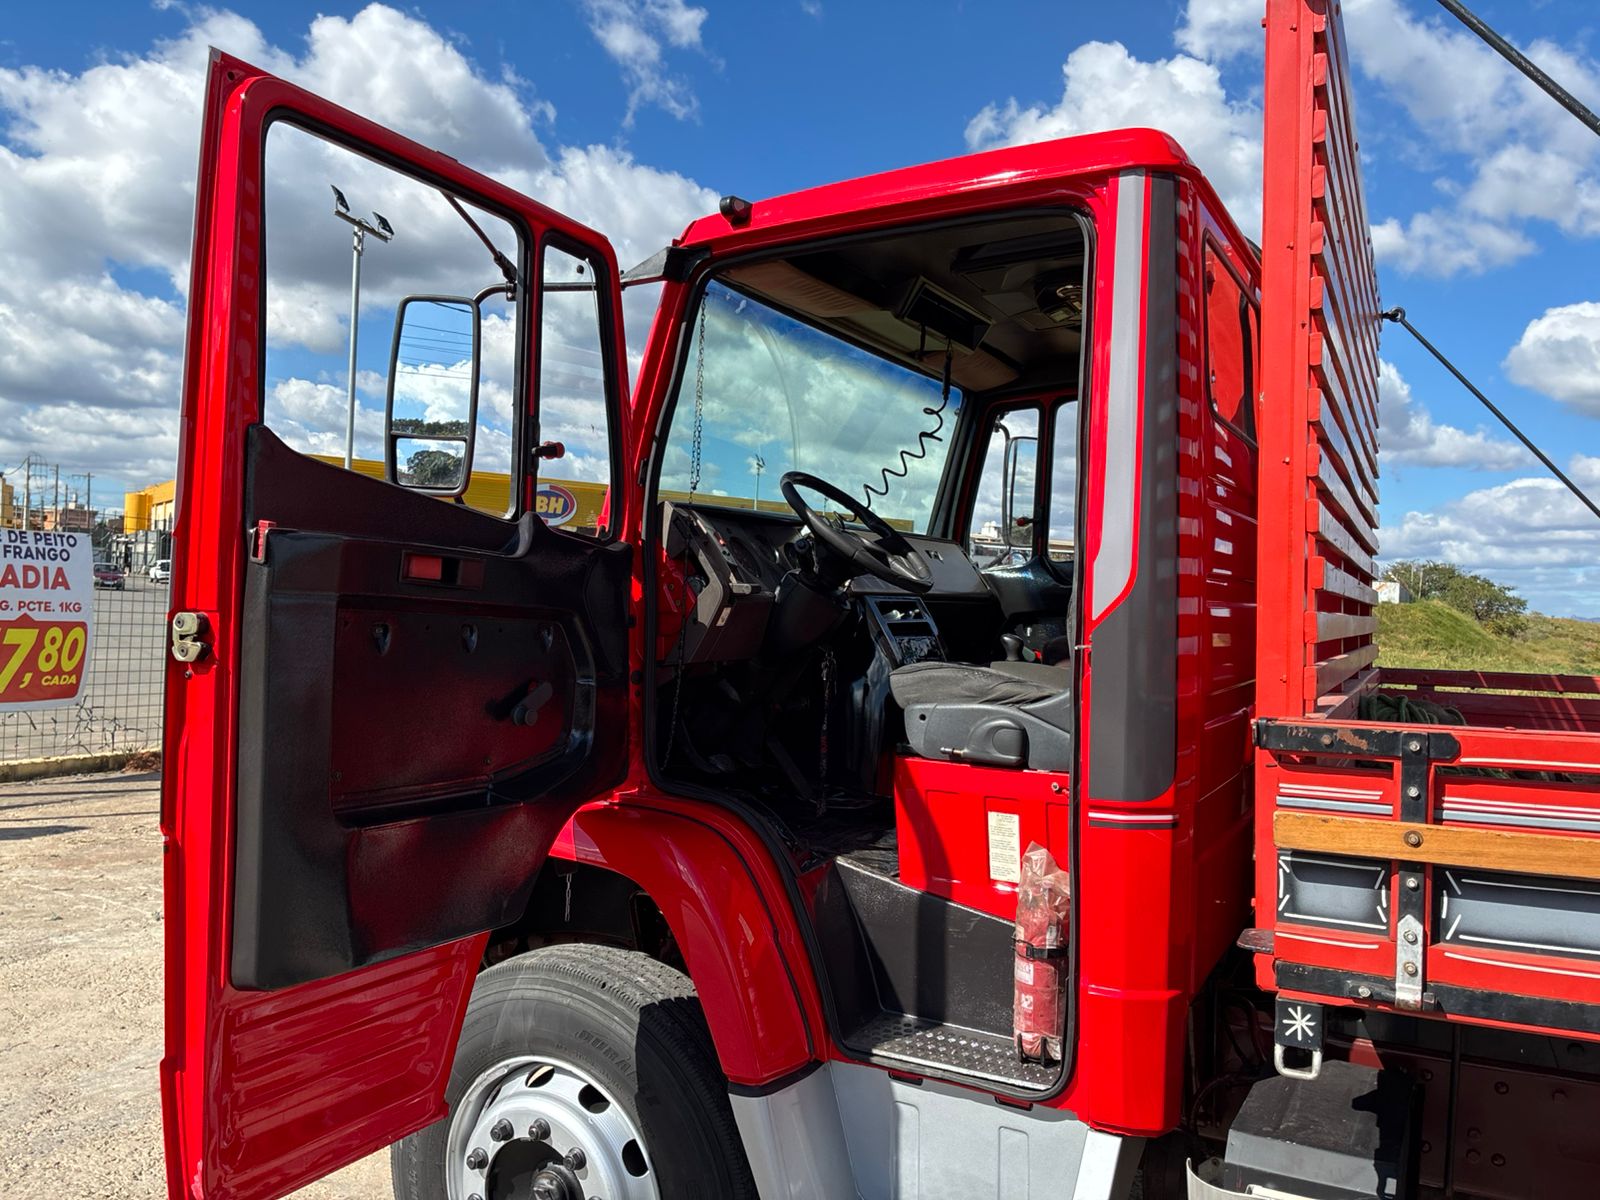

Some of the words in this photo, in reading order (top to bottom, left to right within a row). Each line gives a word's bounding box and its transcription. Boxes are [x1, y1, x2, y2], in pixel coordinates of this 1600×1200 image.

[536, 495, 564, 514] BH
[8, 530, 27, 544] DE
[34, 532, 77, 548] PEITO
[3, 545, 70, 562] FRANGO
[18, 601, 55, 612] PCTE.
[59, 602, 82, 612] 1KG
[0, 626, 86, 694] 7,80
[41, 675, 77, 686] CADA
